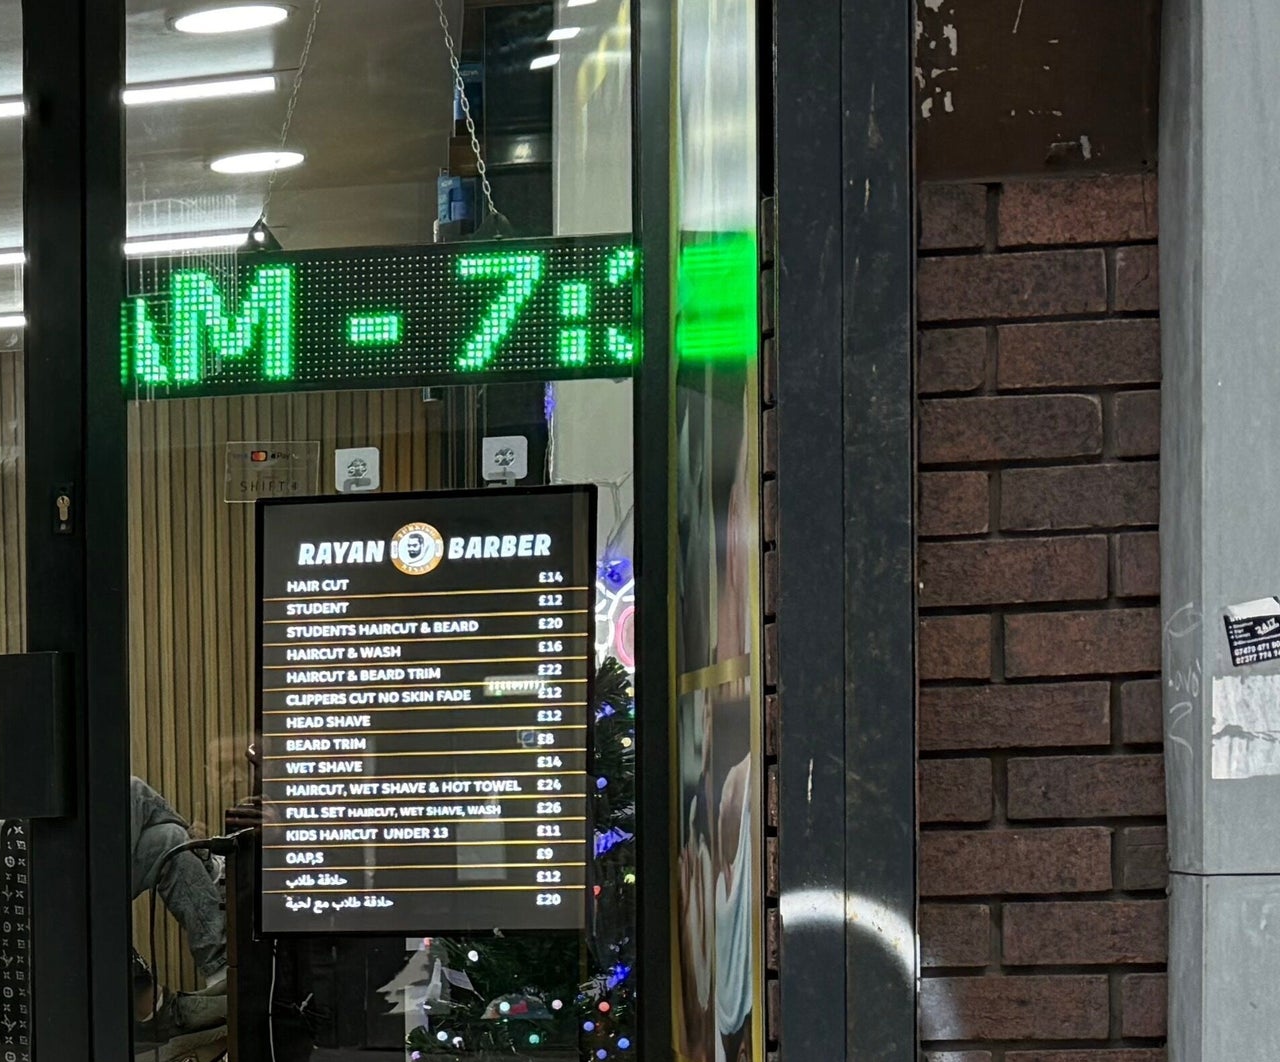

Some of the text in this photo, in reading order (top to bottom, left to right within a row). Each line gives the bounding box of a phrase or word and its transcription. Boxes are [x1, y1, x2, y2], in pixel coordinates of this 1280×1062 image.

[135, 267, 292, 383] M
[297, 533, 552, 565] RAYAN BARBER
[286, 571, 563, 592] HAIR CUT £14
[286, 594, 563, 615] STUDENT £12
[286, 617, 563, 638] STUDENTS HAIRCUT & BEARD £20
[286, 640, 563, 661] HAIRCUT & WASH £16
[286, 663, 563, 683] HAIRCUT & BEARD TRIM £22
[286, 686, 563, 706] CLIPPERS CUT NO SKIN FADE £12
[286, 709, 562, 729] HEAD SHAVE £12
[286, 733, 554, 751] BEARD TRIM £8
[286, 756, 562, 774] WET SHAVE £14
[286, 779, 562, 797] HAIRCUT, WET SHAVE & HOT TOWEL £24
[286, 801, 562, 819] FULL SET HAIRCUT, WET SHAVE, WASH £26
[286, 825, 561, 841] KIDS HAIRCUT UNDER 13 £11
[536, 847, 553, 860] £9
[536, 870, 561, 883] £12
[536, 893, 561, 906] £20
